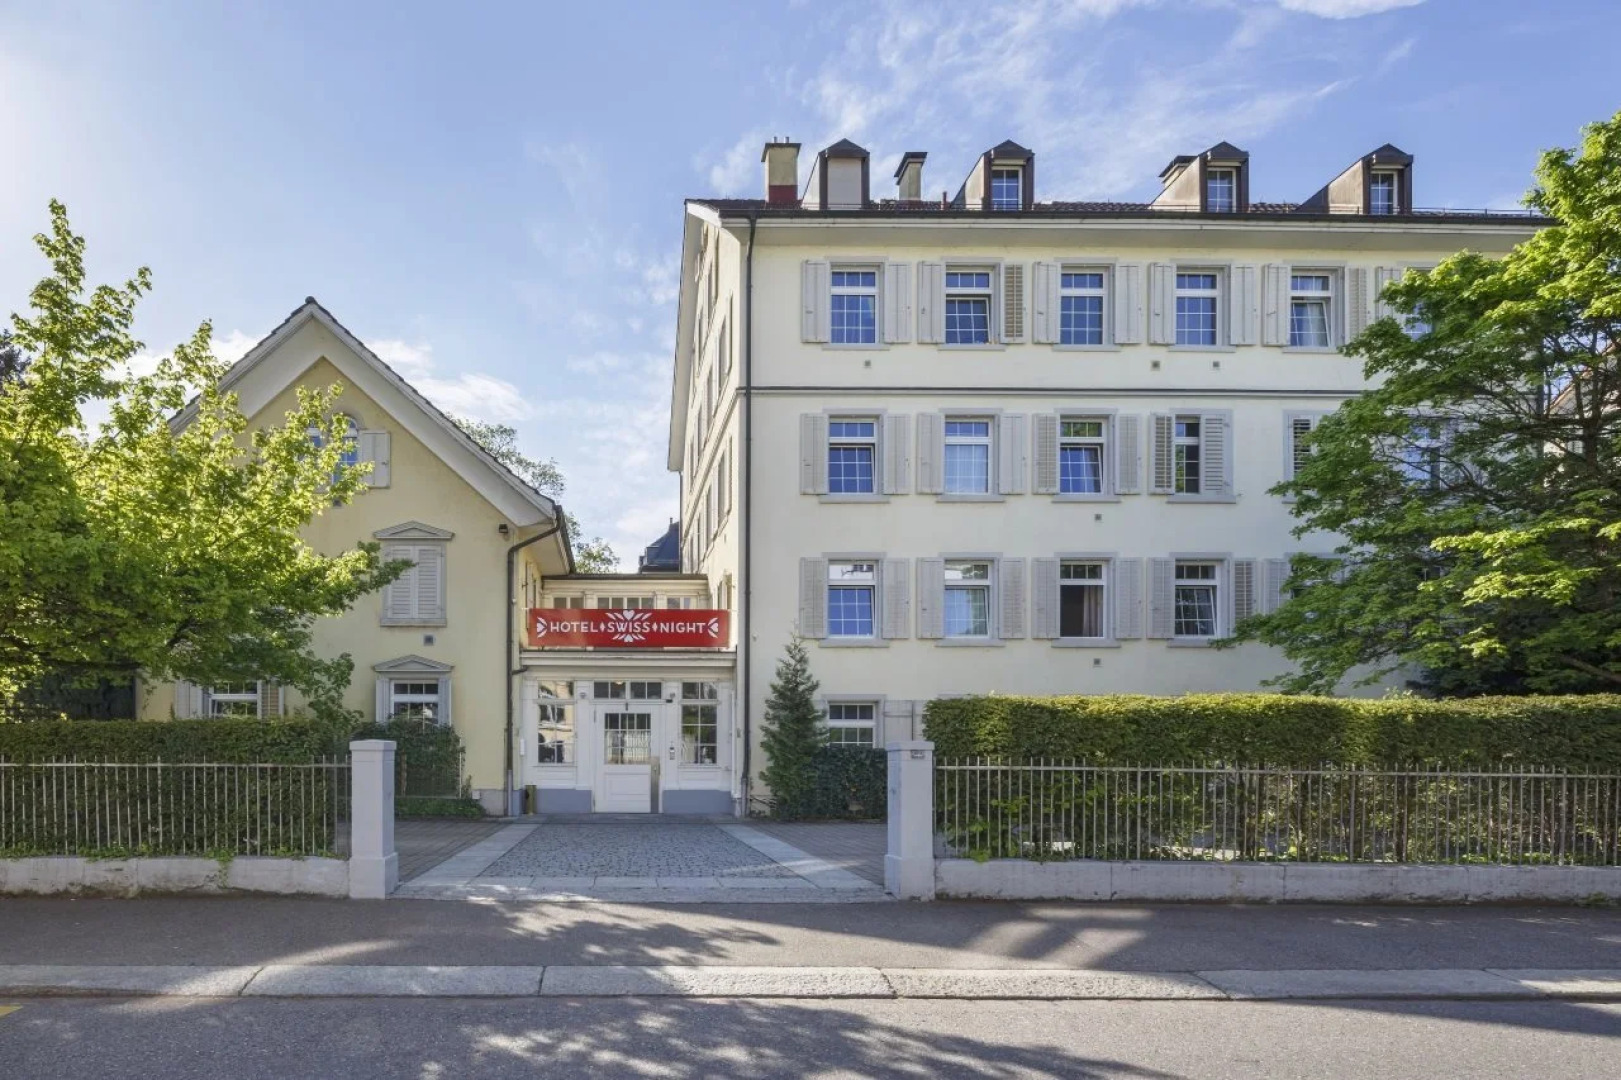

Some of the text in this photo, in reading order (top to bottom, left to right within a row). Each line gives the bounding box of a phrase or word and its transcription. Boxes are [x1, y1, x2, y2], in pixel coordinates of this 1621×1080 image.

[550, 621, 706, 633] HOTEL SWISS NIGHT
